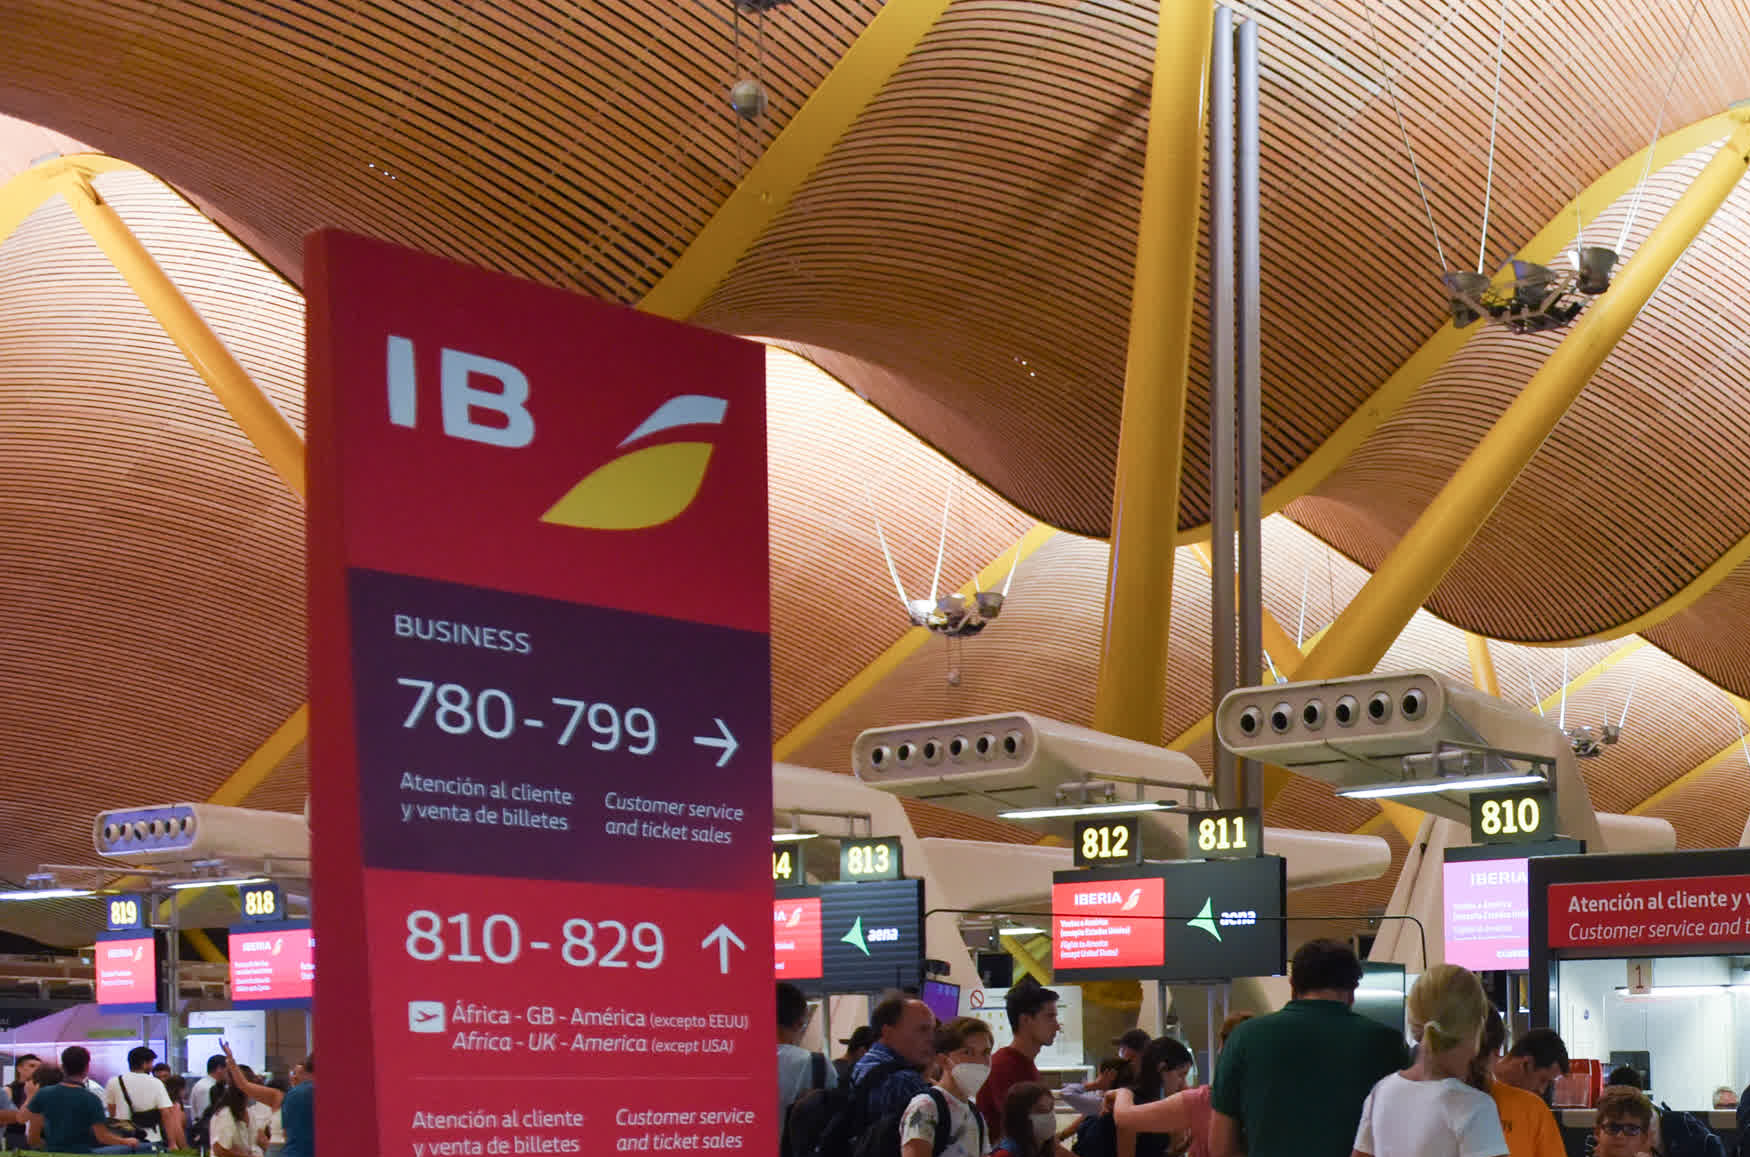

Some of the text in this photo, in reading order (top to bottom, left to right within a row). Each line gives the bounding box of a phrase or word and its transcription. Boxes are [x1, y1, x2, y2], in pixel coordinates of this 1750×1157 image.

[386, 335, 535, 449] IB
[394, 613, 532, 654] BUSINESS
[400, 771, 573, 807] Atención al cliente
[400, 802, 569, 831] y venta de billetes
[604, 792, 744, 822] Customer service
[1481, 797, 1540, 835] 810
[604, 819, 732, 845] and ticket sales
[1082, 825, 1129, 859] 812
[1199, 816, 1247, 850] 811
[773, 851, 792, 879] 14
[847, 844, 890, 874] 813
[245, 890, 275, 915] 818
[1073, 891, 1122, 906] IBERIA
[1568, 892, 1644, 914] Atención
[1647, 891, 1664, 911] al
[1667, 887, 1728, 909] cliente
[1730, 891, 1742, 911] y
[110, 900, 137, 925] 819
[1568, 921, 1645, 942] Customer
[1647, 919, 1705, 938] service
[1708, 916, 1741, 937] and
[1634, 964, 1644, 989] 1
[452, 1000, 510, 1025] África
[527, 1006, 555, 1025] GB
[570, 1006, 645, 1027] América
[650, 1013, 707, 1032] (excepto
[708, 1014, 749, 1030] EEUU)
[452, 1033, 512, 1052] Africa
[528, 1033, 558, 1052] UK
[570, 1033, 648, 1053] America
[650, 1037, 700, 1055] (except
[701, 1038, 735, 1055] USA)
[412, 1109, 583, 1129] Atención al cliente
[615, 1108, 755, 1127] Customer service
[428, 1138, 482, 1156] venta
[487, 1137, 510, 1155] de
[513, 1135, 580, 1155] billetes
[616, 1133, 743, 1152] and ticket sales
